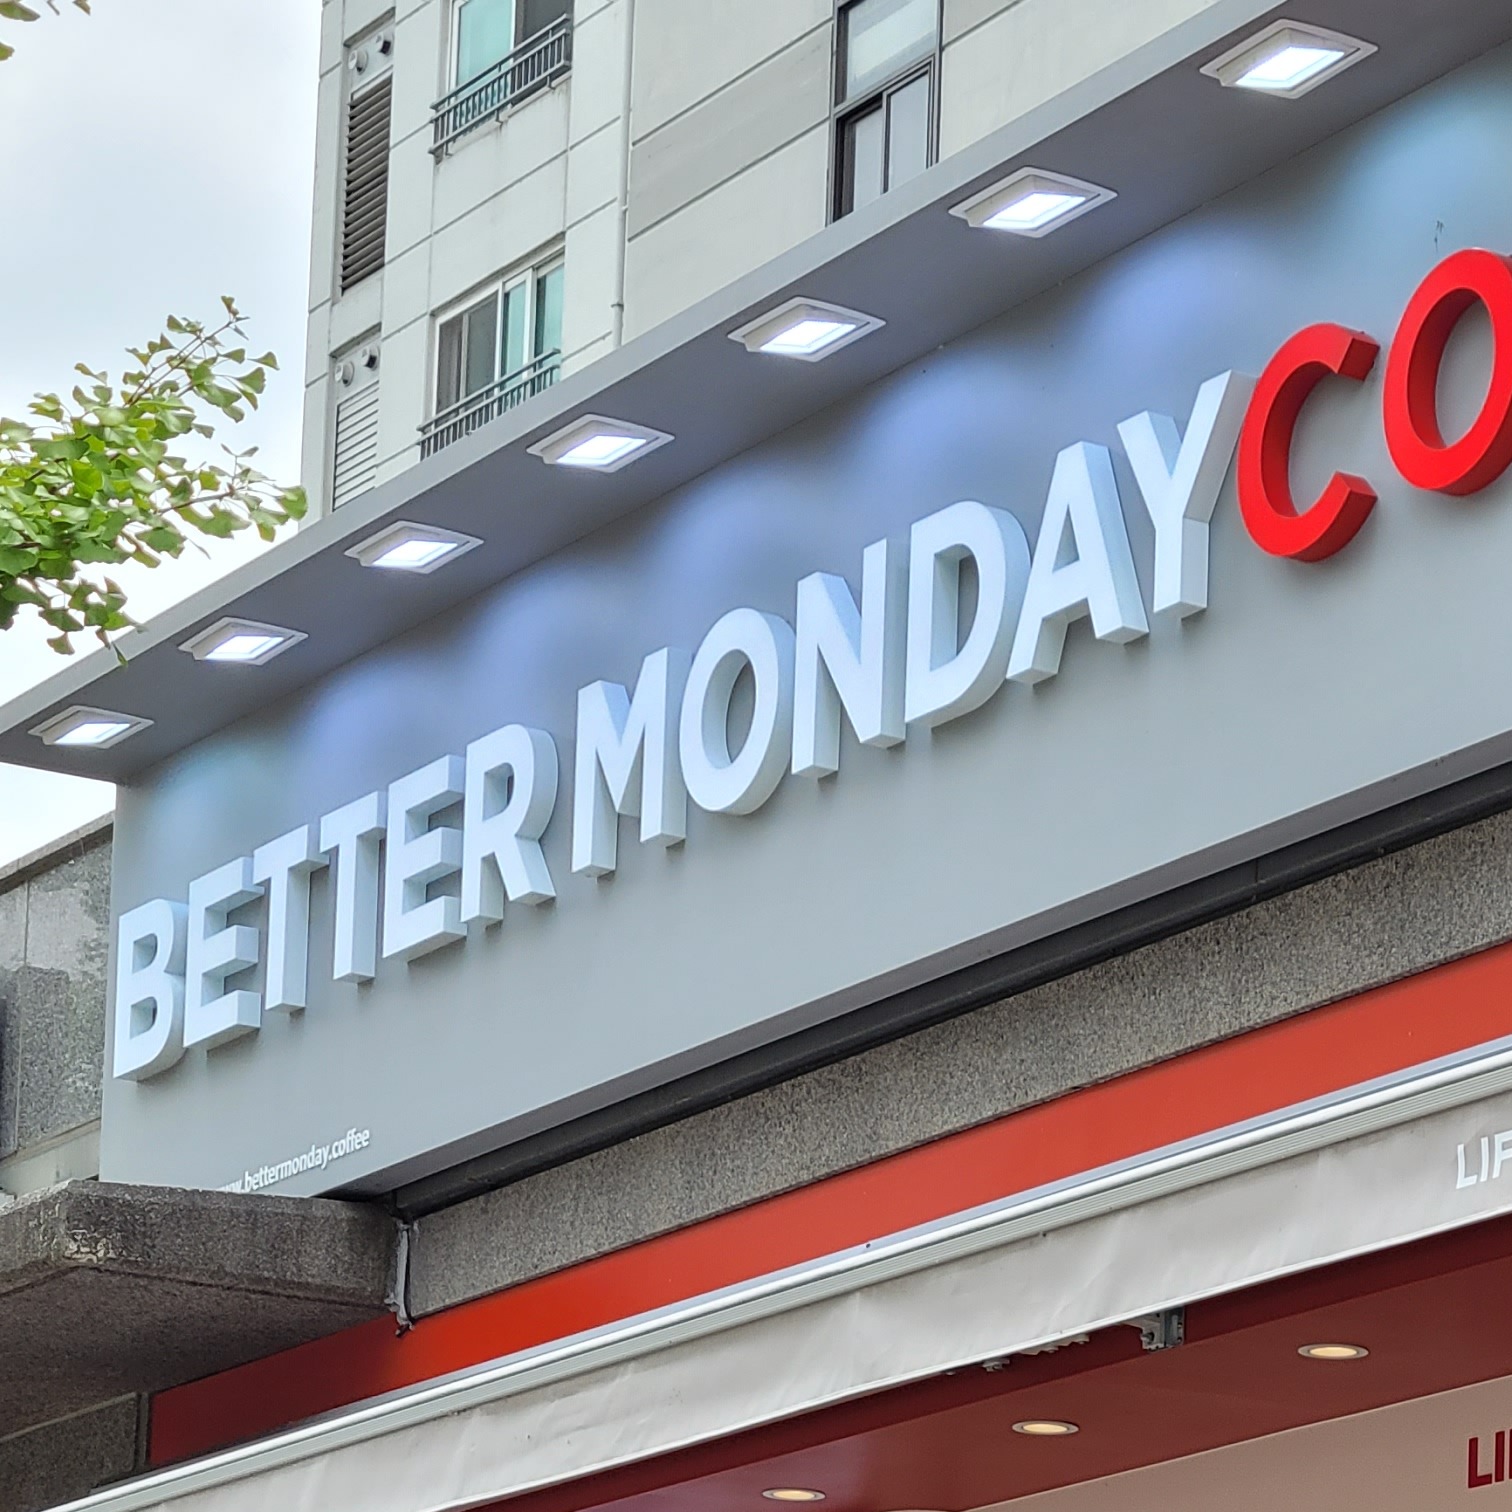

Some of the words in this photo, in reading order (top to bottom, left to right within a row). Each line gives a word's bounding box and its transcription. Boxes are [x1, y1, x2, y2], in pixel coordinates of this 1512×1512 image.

[113, 723, 558, 1080] BETTER
[571, 370, 1257, 876] MONDAY
[204, 1127, 370, 1193] ww.bettermonday.coffee
